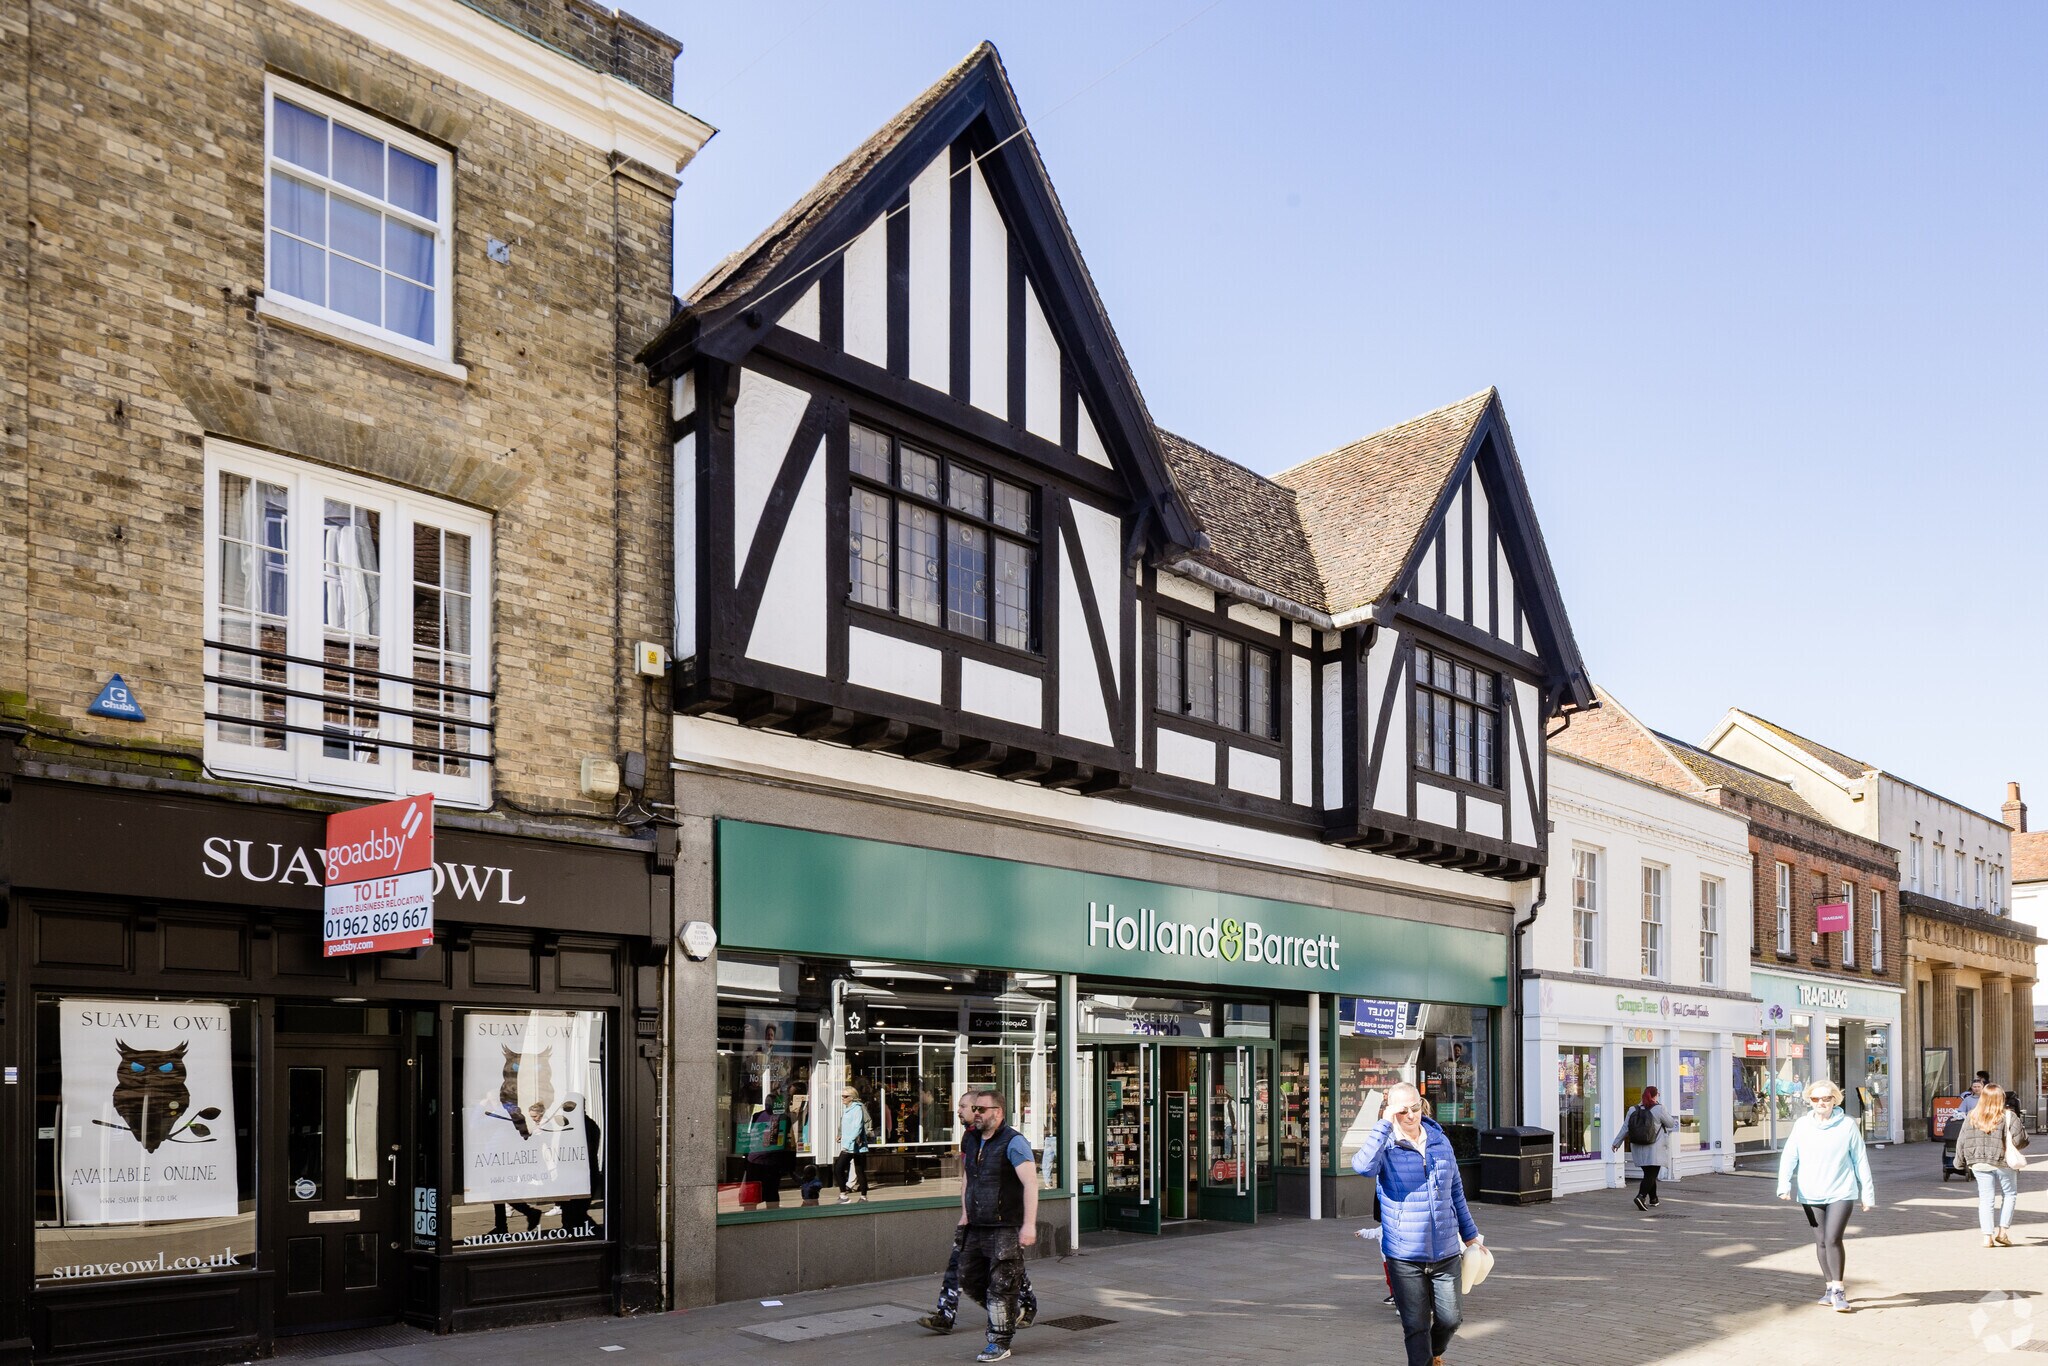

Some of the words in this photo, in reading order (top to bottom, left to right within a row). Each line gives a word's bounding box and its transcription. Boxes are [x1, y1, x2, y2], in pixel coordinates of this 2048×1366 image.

[101, 699, 136, 712] Chubb
[202, 836, 325, 887] SUA
[327, 827, 407, 881] goadsby
[353, 883, 372, 903] TO
[375, 878, 399, 900] LET
[331, 906, 344, 916] DUE
[345, 905, 354, 914] TO
[355, 900, 385, 912] BUSINESS
[385, 894, 425, 909] RELOCATION
[325, 915, 369, 939] 01962
[372, 911, 399, 933] 869
[402, 906, 429, 929] 667
[327, 940, 374, 956] goadsby.com
[1798, 985, 1848, 1010] TRAVELBAG
[81, 1011, 161, 1030] SUAVE
[173, 1015, 228, 1032] OWL
[1125, 1011, 1155, 1023] SINCE
[1158, 1013, 1180, 1024] 1870
[751, 1062, 761, 1071] No
[749, 1074, 760, 1083] No
[474, 1149, 538, 1168] AVAILABLE
[70, 1166, 151, 1186] AVAILABLE
[163, 1165, 218, 1182] ONLINE
[463, 1220, 596, 1247] suaveowl.co.uk
[52, 1246, 240, 1281] suaveowl.co.uk
